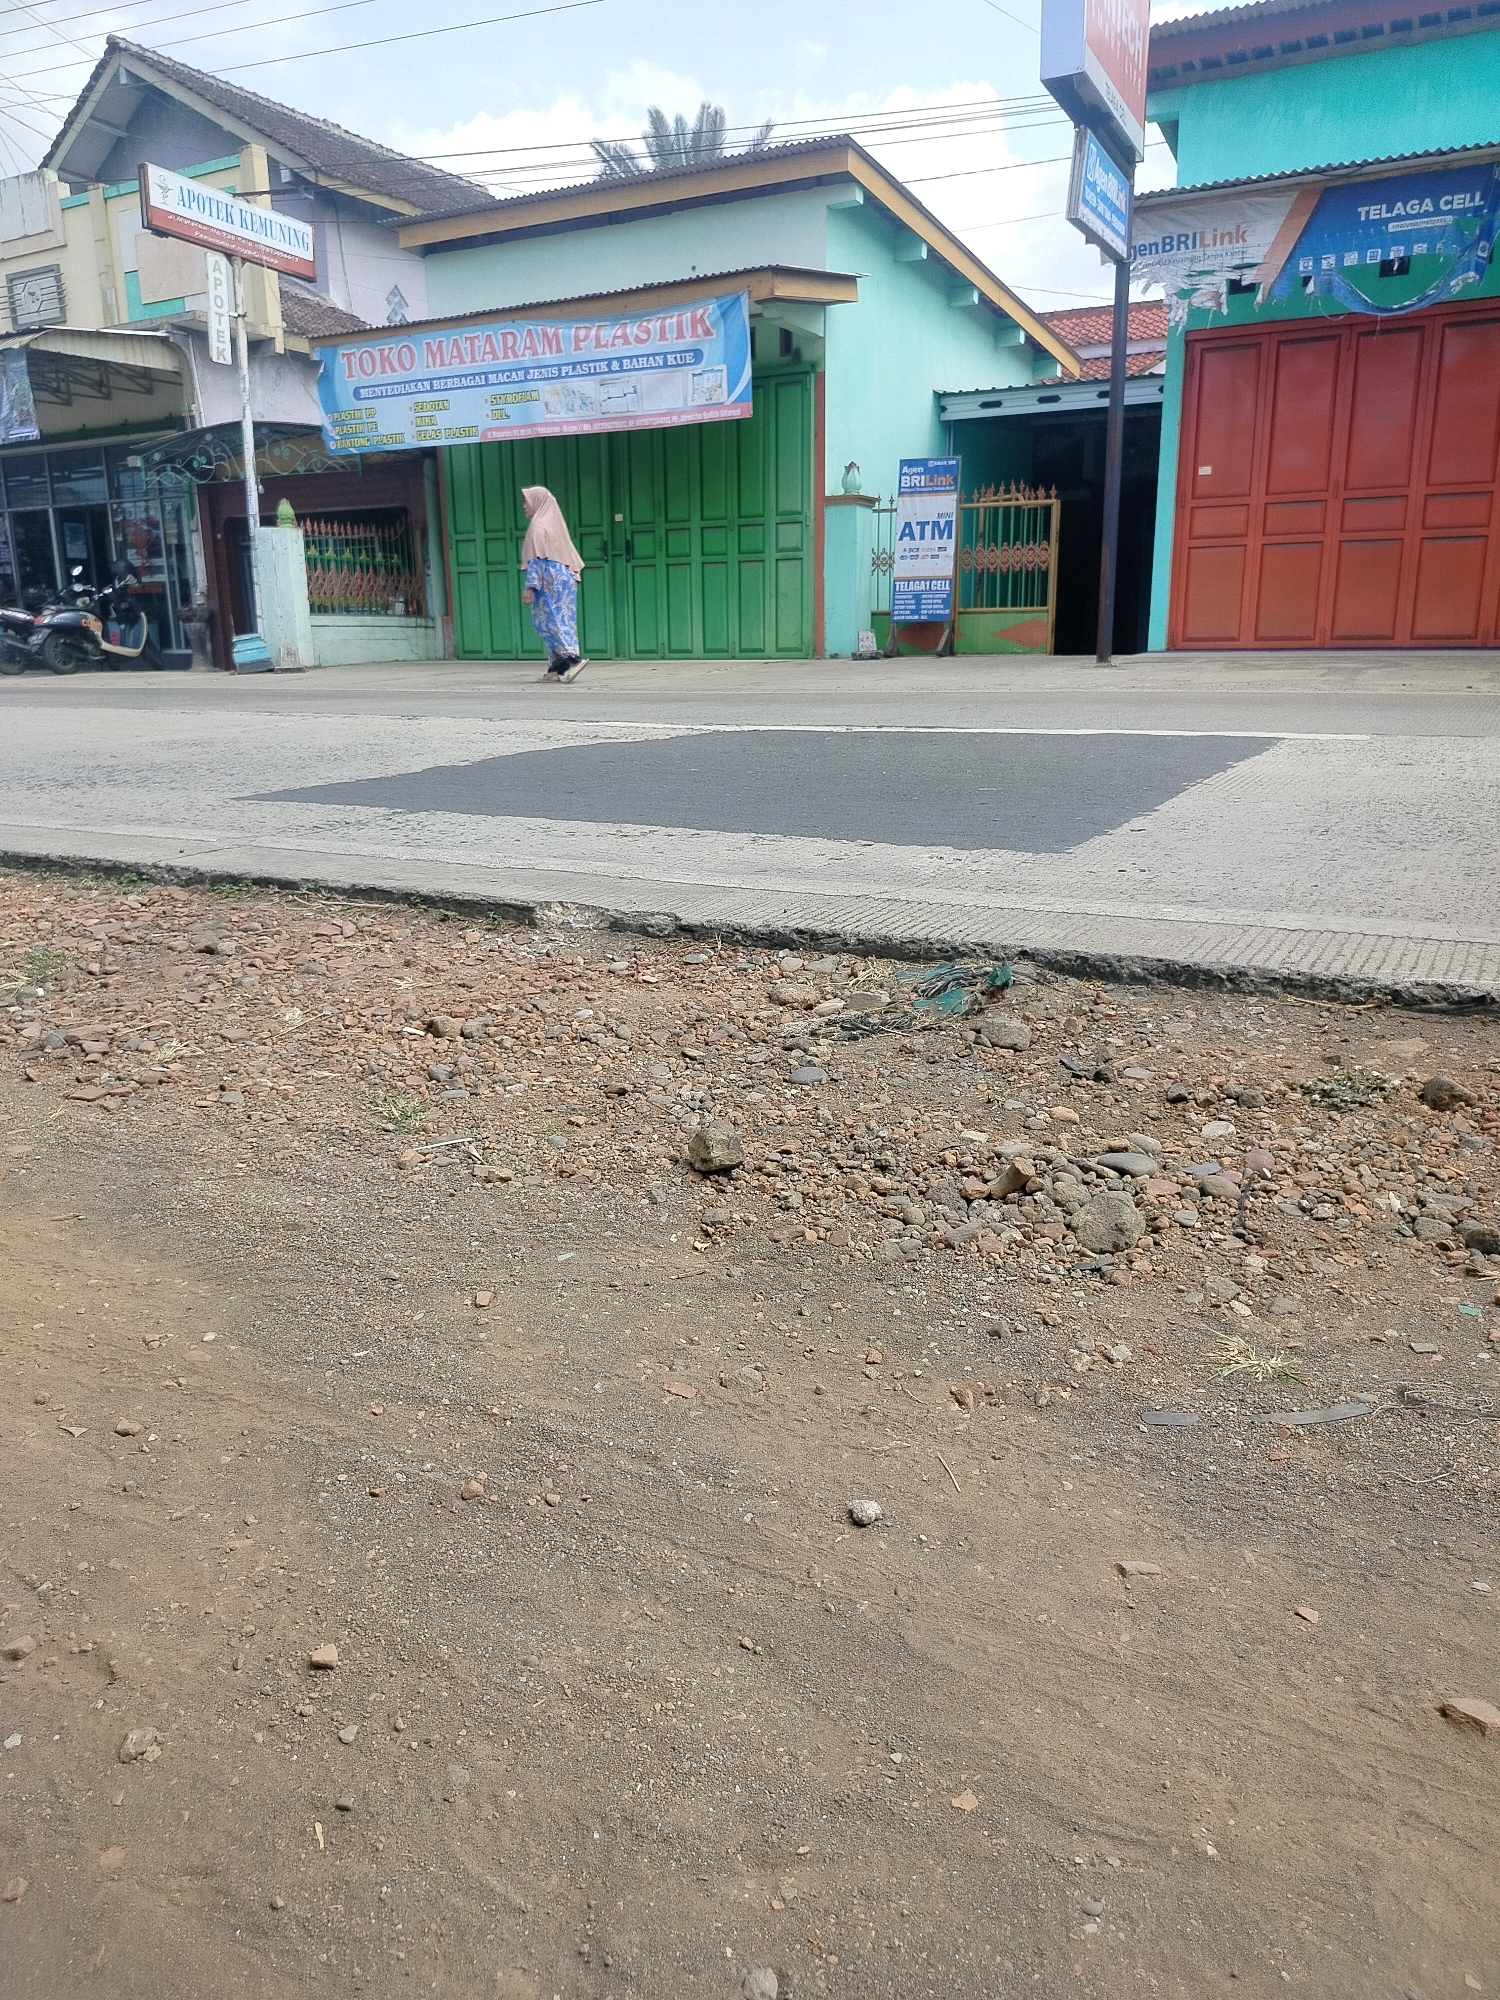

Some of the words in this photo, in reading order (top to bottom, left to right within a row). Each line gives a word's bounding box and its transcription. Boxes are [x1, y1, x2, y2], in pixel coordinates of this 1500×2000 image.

[1124, 53, 1141, 95] LIFE
[1357, 198, 1434, 221] TELAGA
[1440, 191, 1484, 211] CELL
[177, 185, 235, 225] APOTEK
[239, 207, 310, 252] KEMUNING
[1130, 225, 1248, 260] genBRILink
[212, 260, 227, 361] APOTEK
[340, 343, 417, 379] TOKO
[424, 326, 564, 370] MATARAM
[572, 306, 715, 352] PLASTIK
[360, 381, 431, 399] MENYEDIAKAN
[433, 374, 486, 390] BERBAGAI
[527, 367, 559, 380] JENIS
[561, 362, 608, 376] PLASTIK
[611, 360, 621, 371] &
[622, 355, 666, 370] BAHAN
[667, 352, 695, 365] KUE
[414, 400, 450, 413] SEDOTAN
[333, 409, 365, 421] PLASTIK
[415, 416, 438, 427] MIKA
[334, 423, 365, 435] PLASTIK
[444, 426, 479, 439] PLASTIK
[373, 433, 405, 445] PLASTIK
[901, 465, 924, 475] Agen
[901, 473, 954, 487] BRILink
[898, 519, 953, 541] ATM
[931, 579, 950, 591] CELL
